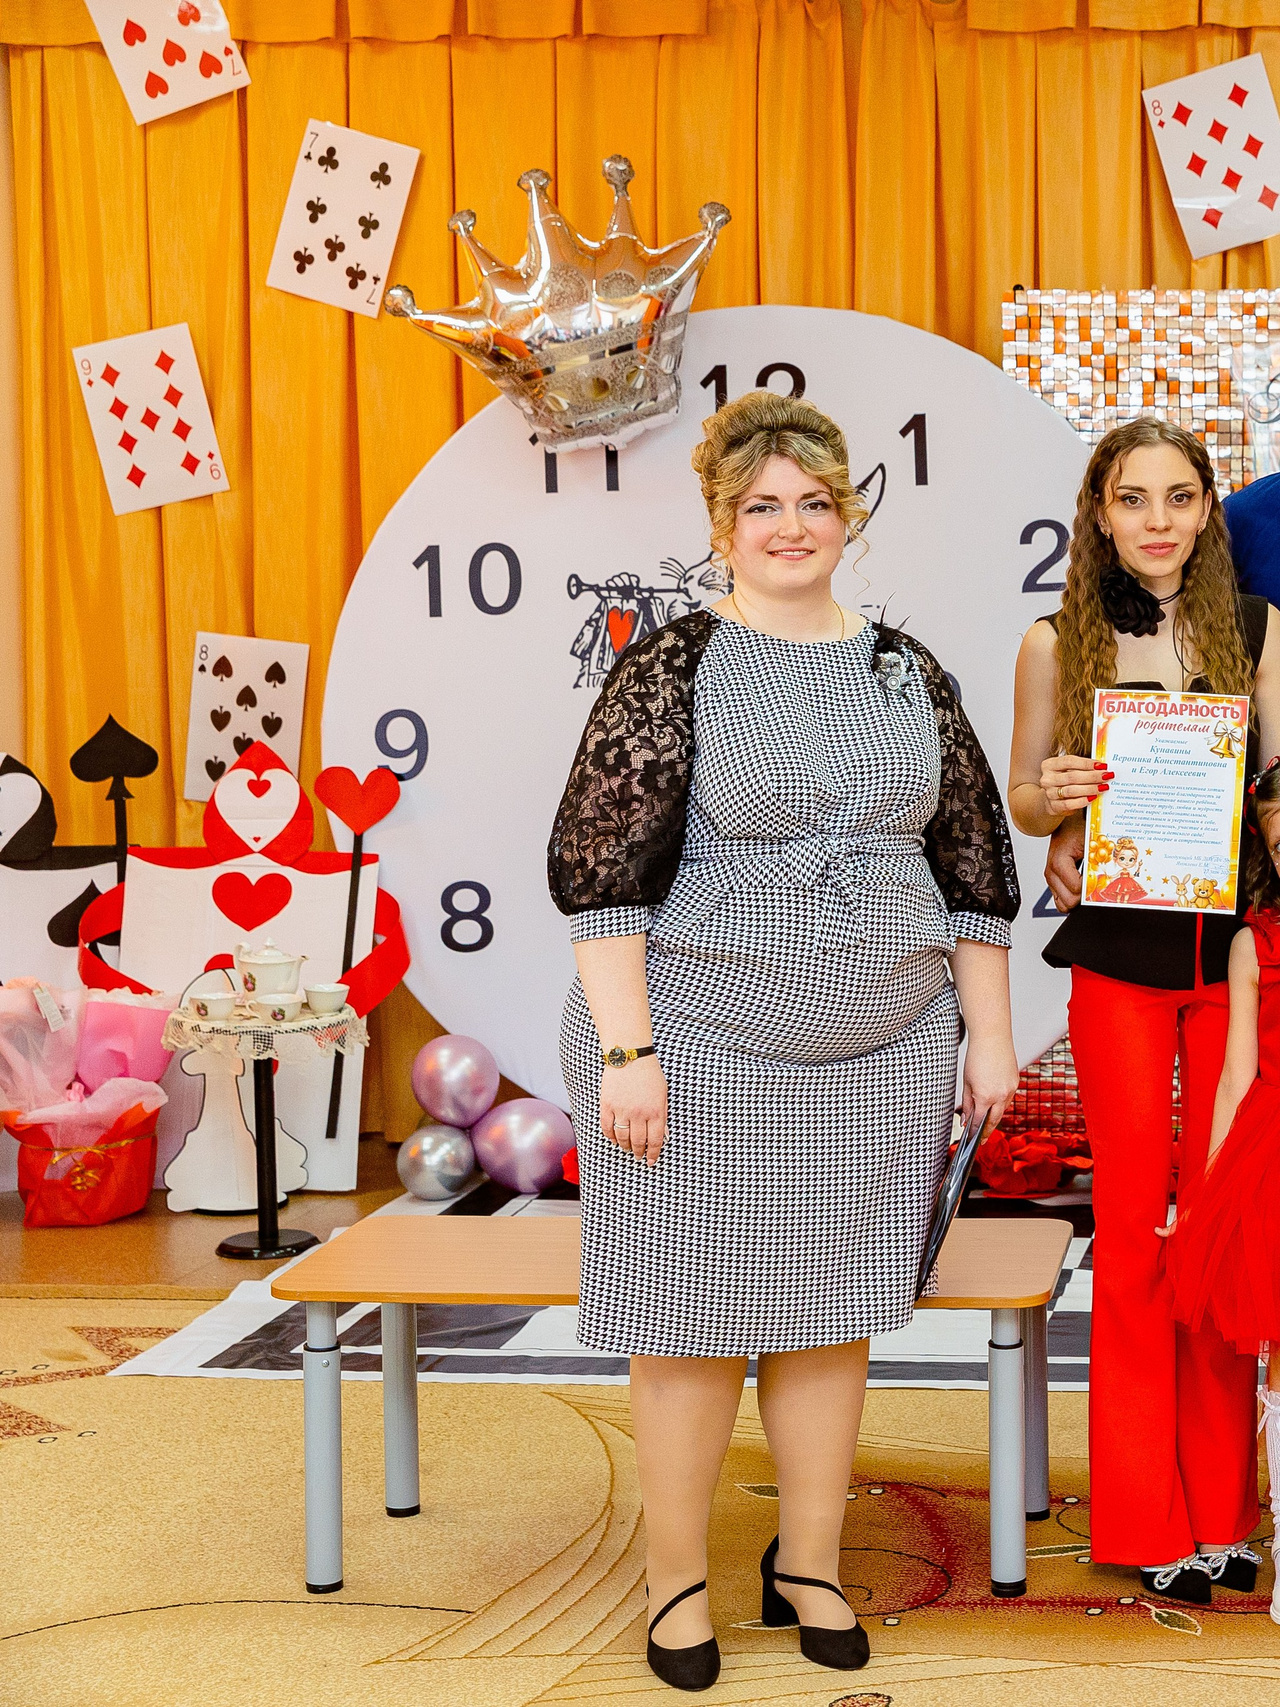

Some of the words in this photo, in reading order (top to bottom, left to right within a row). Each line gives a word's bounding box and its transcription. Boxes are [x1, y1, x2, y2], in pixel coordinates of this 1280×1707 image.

[1151, 99, 1163, 116] 8
[310, 131, 319, 149] 7
[81, 358, 92, 376] 9
[899, 413, 929, 486] 1
[1019, 518, 1070, 594] 2
[412, 542, 523, 618] 10
[199, 644, 209, 661] 8
[1105, 700, 1240, 719] БЛАГОДАРНОСТЬ
[1133, 719, 1210, 735] родителям
[374, 708, 430, 782] 9
[1112, 754, 1152, 763] Вероника
[1154, 756, 1227, 768] Константиновна
[1139, 766, 1158, 776] Егор
[1160, 768, 1207, 777] Алексеевич
[440, 880, 495, 953] 8
